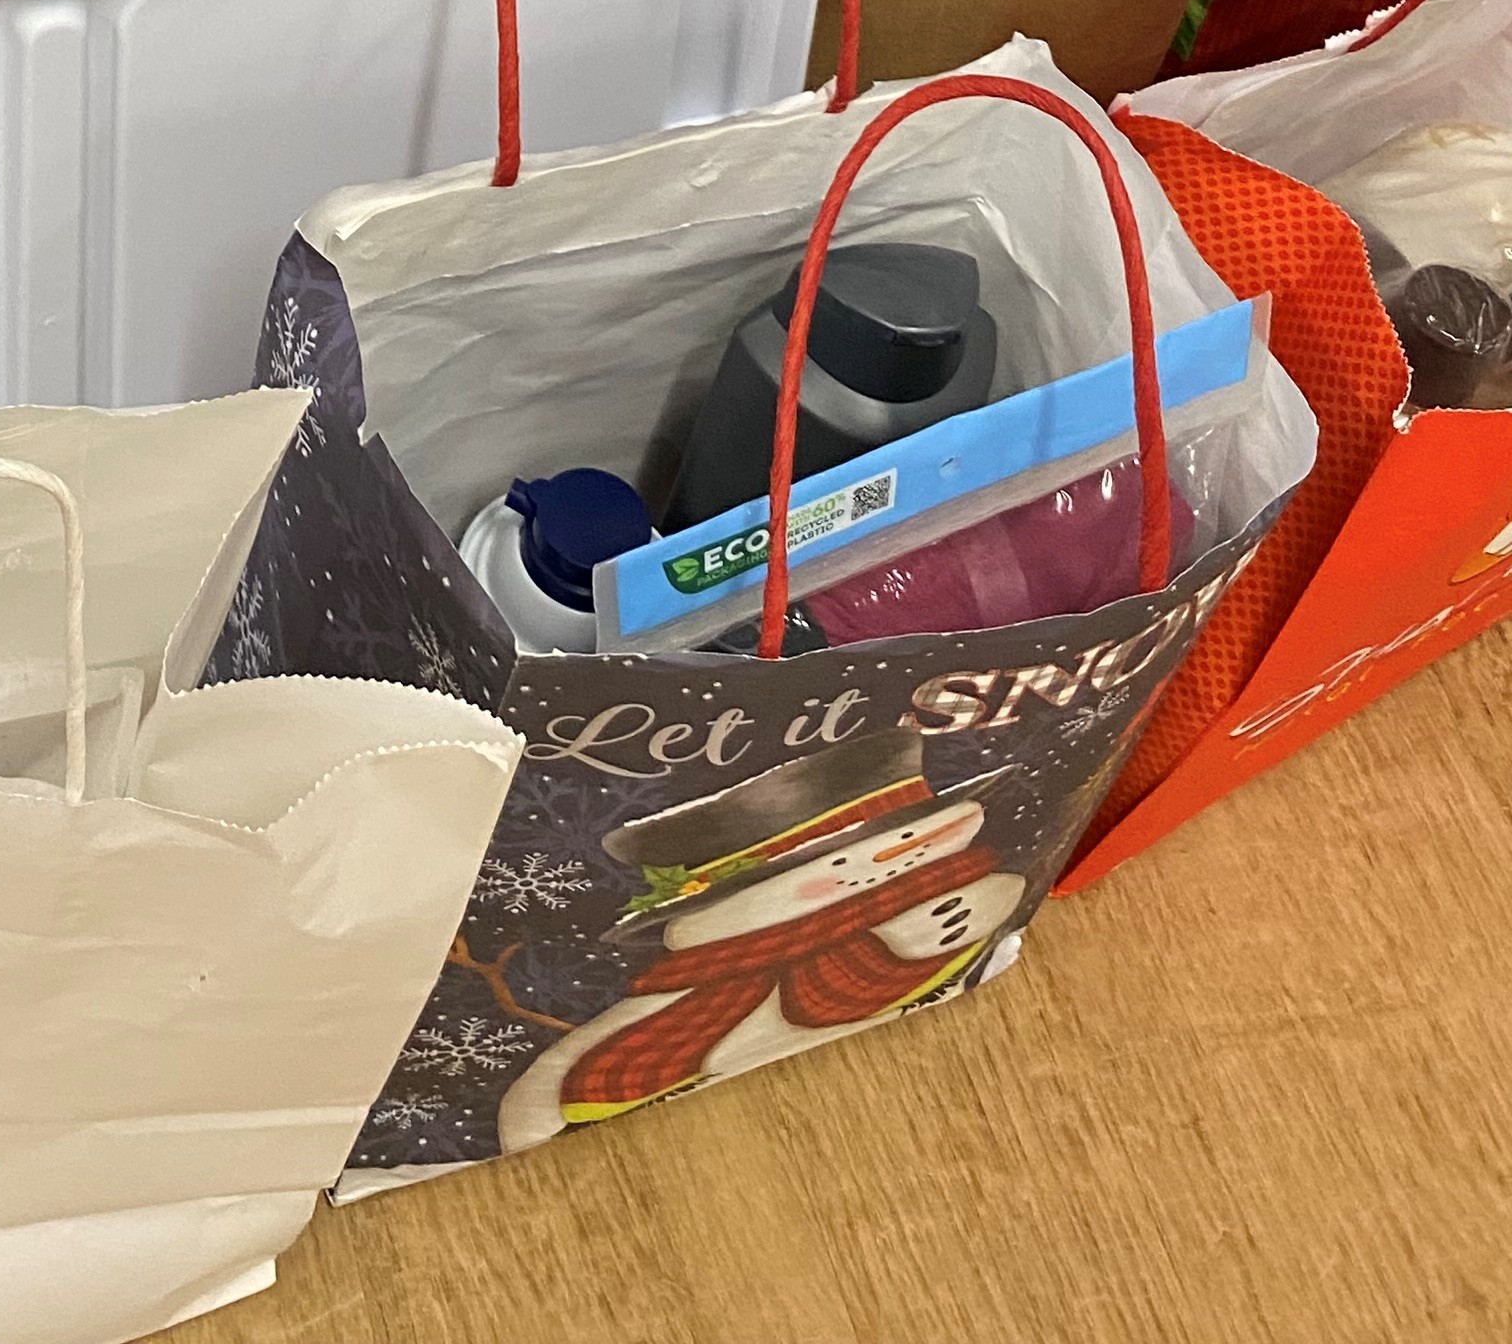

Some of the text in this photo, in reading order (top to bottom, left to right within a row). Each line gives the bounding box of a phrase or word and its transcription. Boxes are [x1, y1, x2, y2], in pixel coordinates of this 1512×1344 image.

[703, 528, 770, 574] ECO
[523, 702, 756, 779] Let
[783, 687, 869, 745] it
